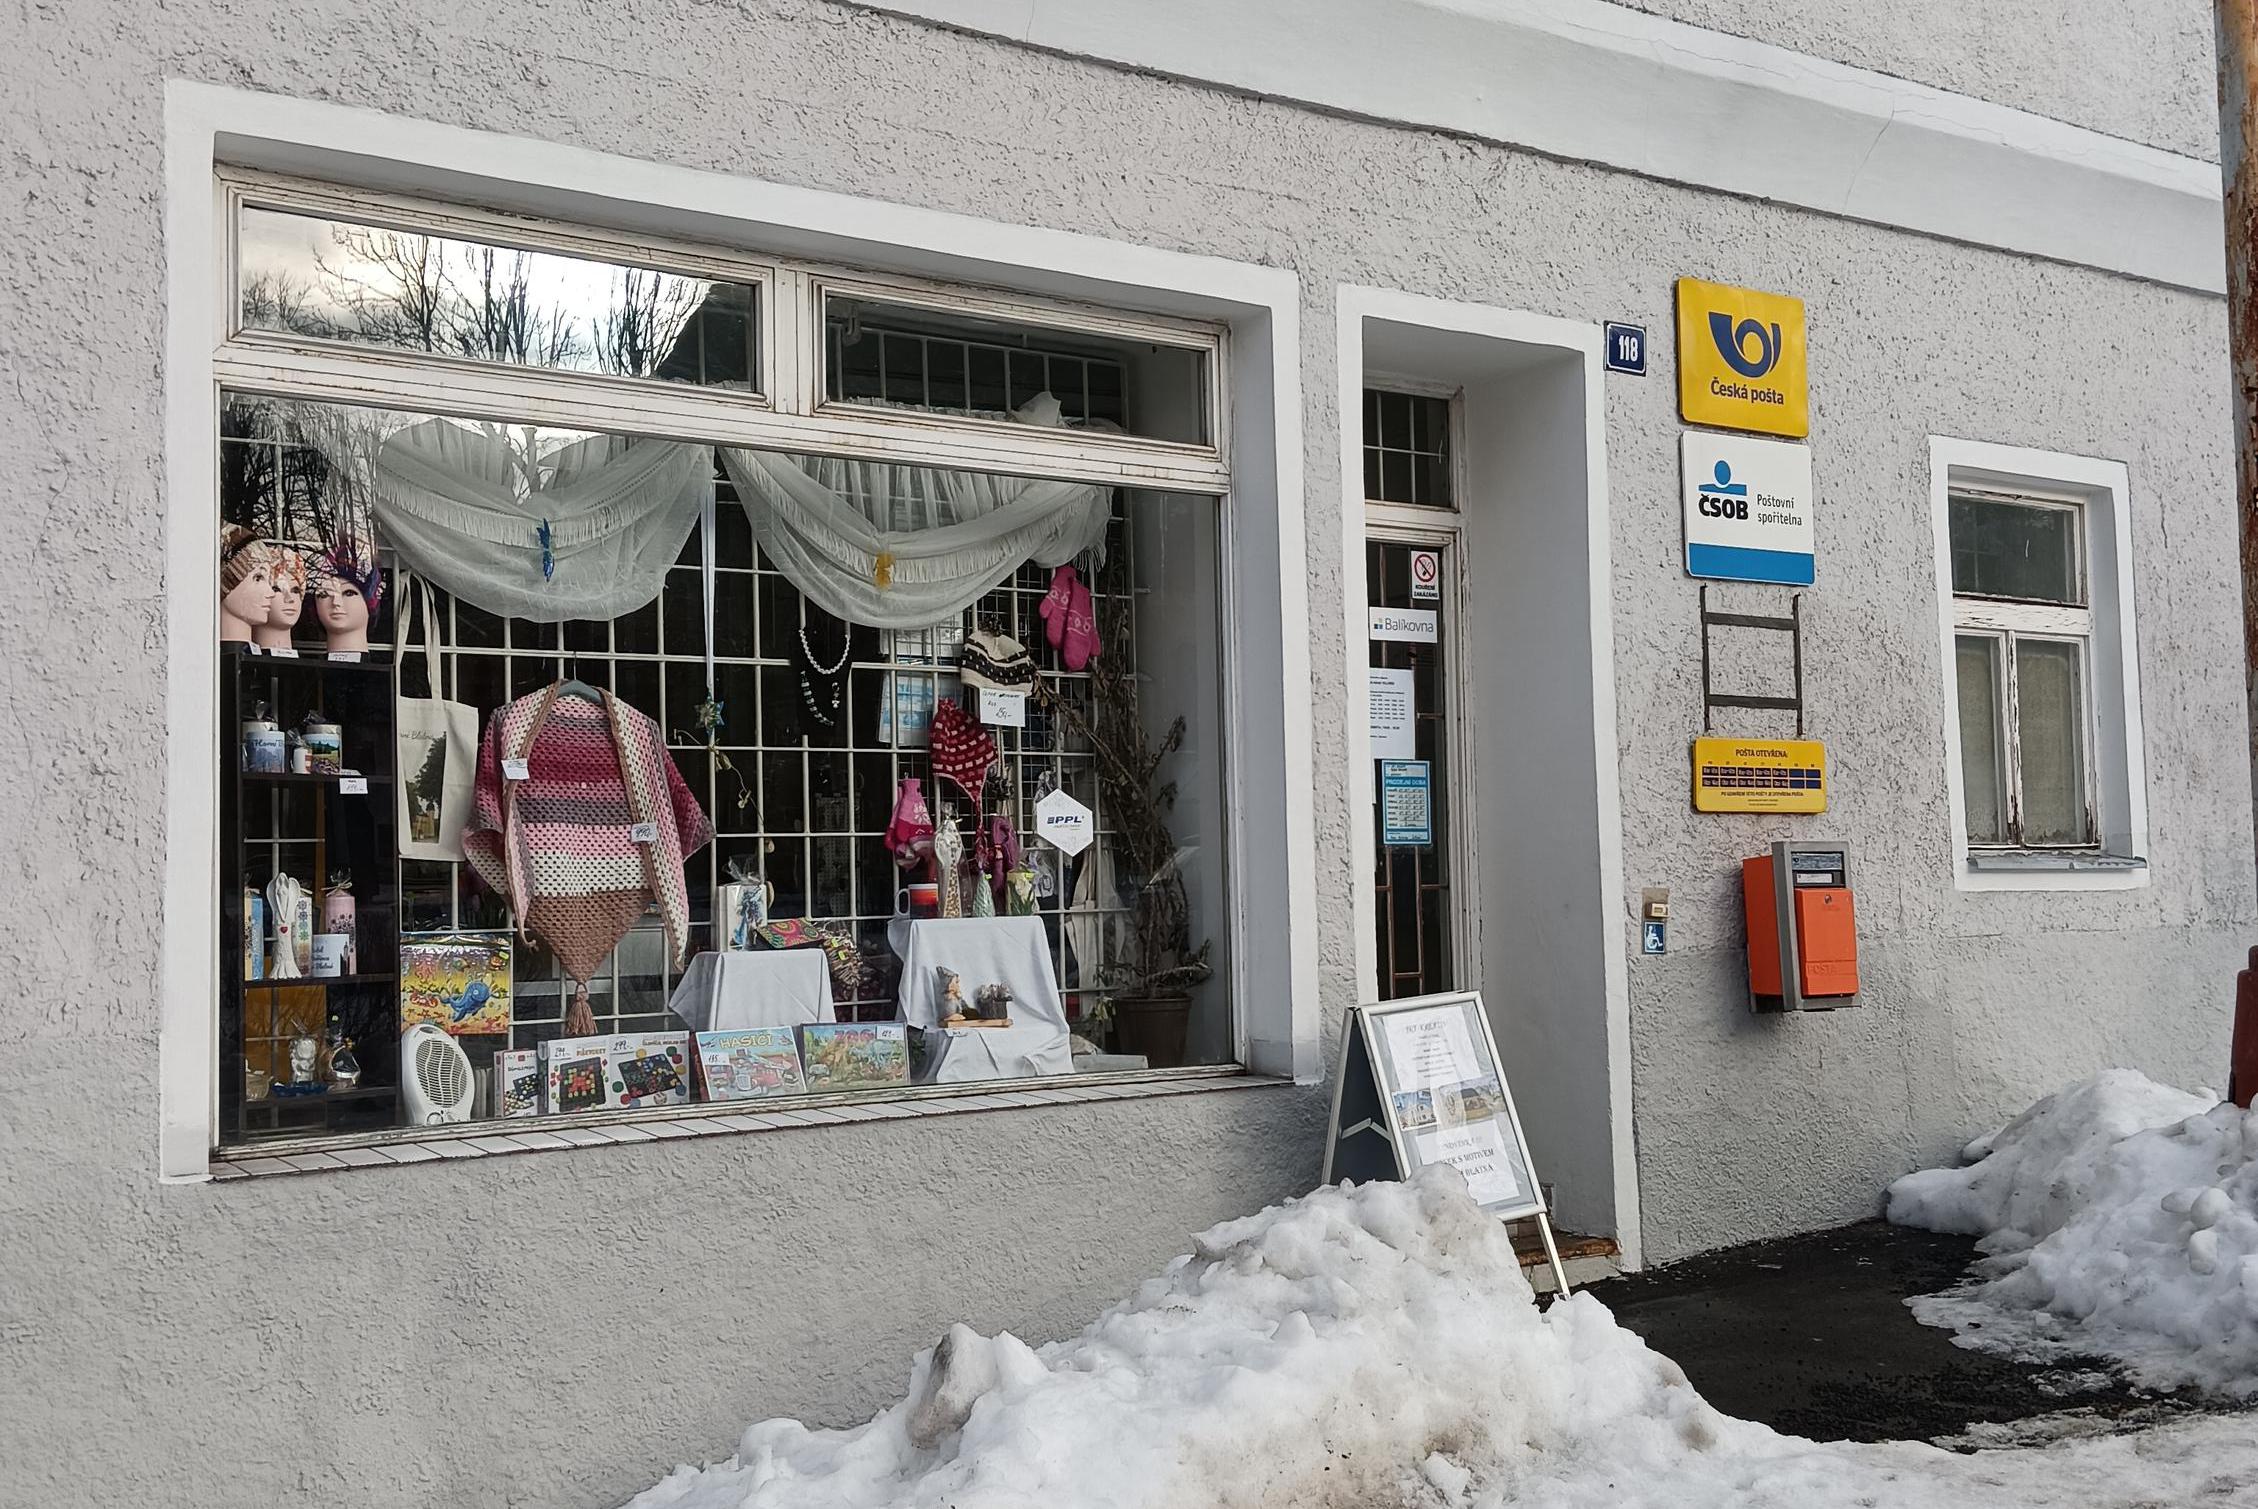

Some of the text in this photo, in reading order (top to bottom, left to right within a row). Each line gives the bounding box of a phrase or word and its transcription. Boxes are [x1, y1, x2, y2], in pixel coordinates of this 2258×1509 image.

[1618, 334, 1639, 362] 118
[1710, 376, 1785, 405] Česká pošta
[1698, 493, 1749, 521] ČSOB
[1757, 493, 1795, 510] Poštovní
[1757, 510, 1803, 527] spořitelna
[1384, 617, 1434, 633] Balíkovna
[1735, 748, 1755, 757] POŠTA
[1055, 815, 1082, 824] PPL
[834, 1028, 875, 1042] ZOO
